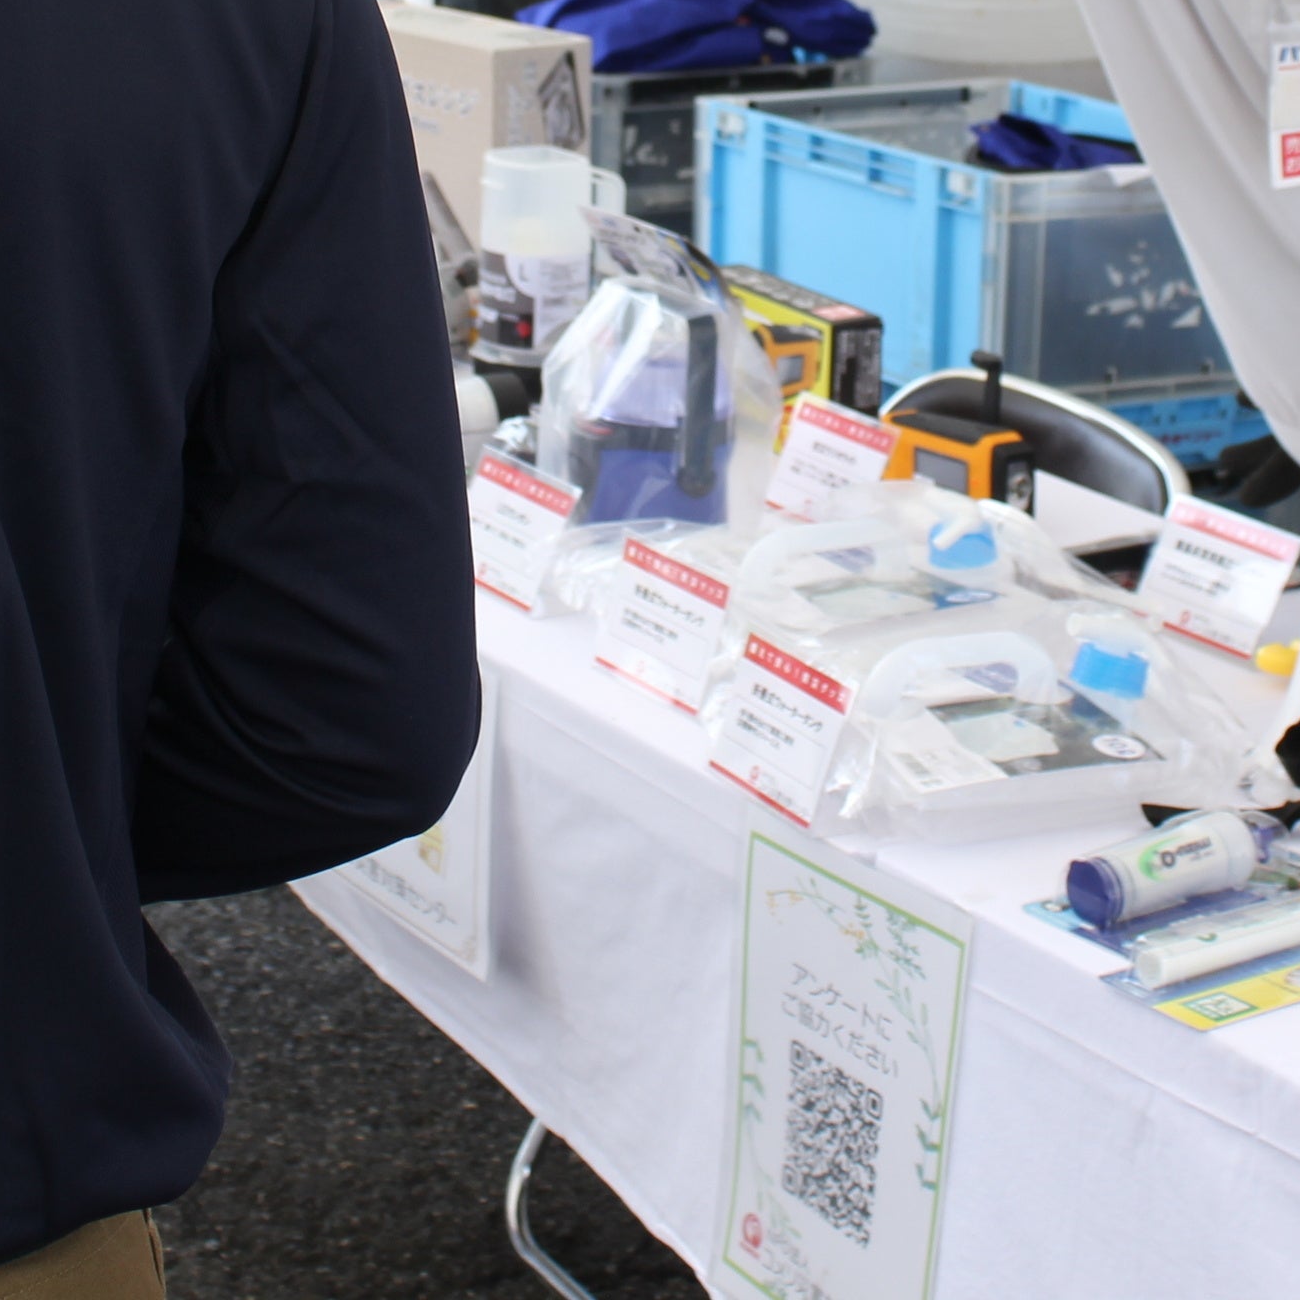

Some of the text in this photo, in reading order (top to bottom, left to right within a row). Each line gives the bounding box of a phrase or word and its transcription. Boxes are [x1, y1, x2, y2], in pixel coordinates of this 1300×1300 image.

[781, 990, 900, 1080] ご協力ください
[790, 961, 894, 1043] アンケートに
